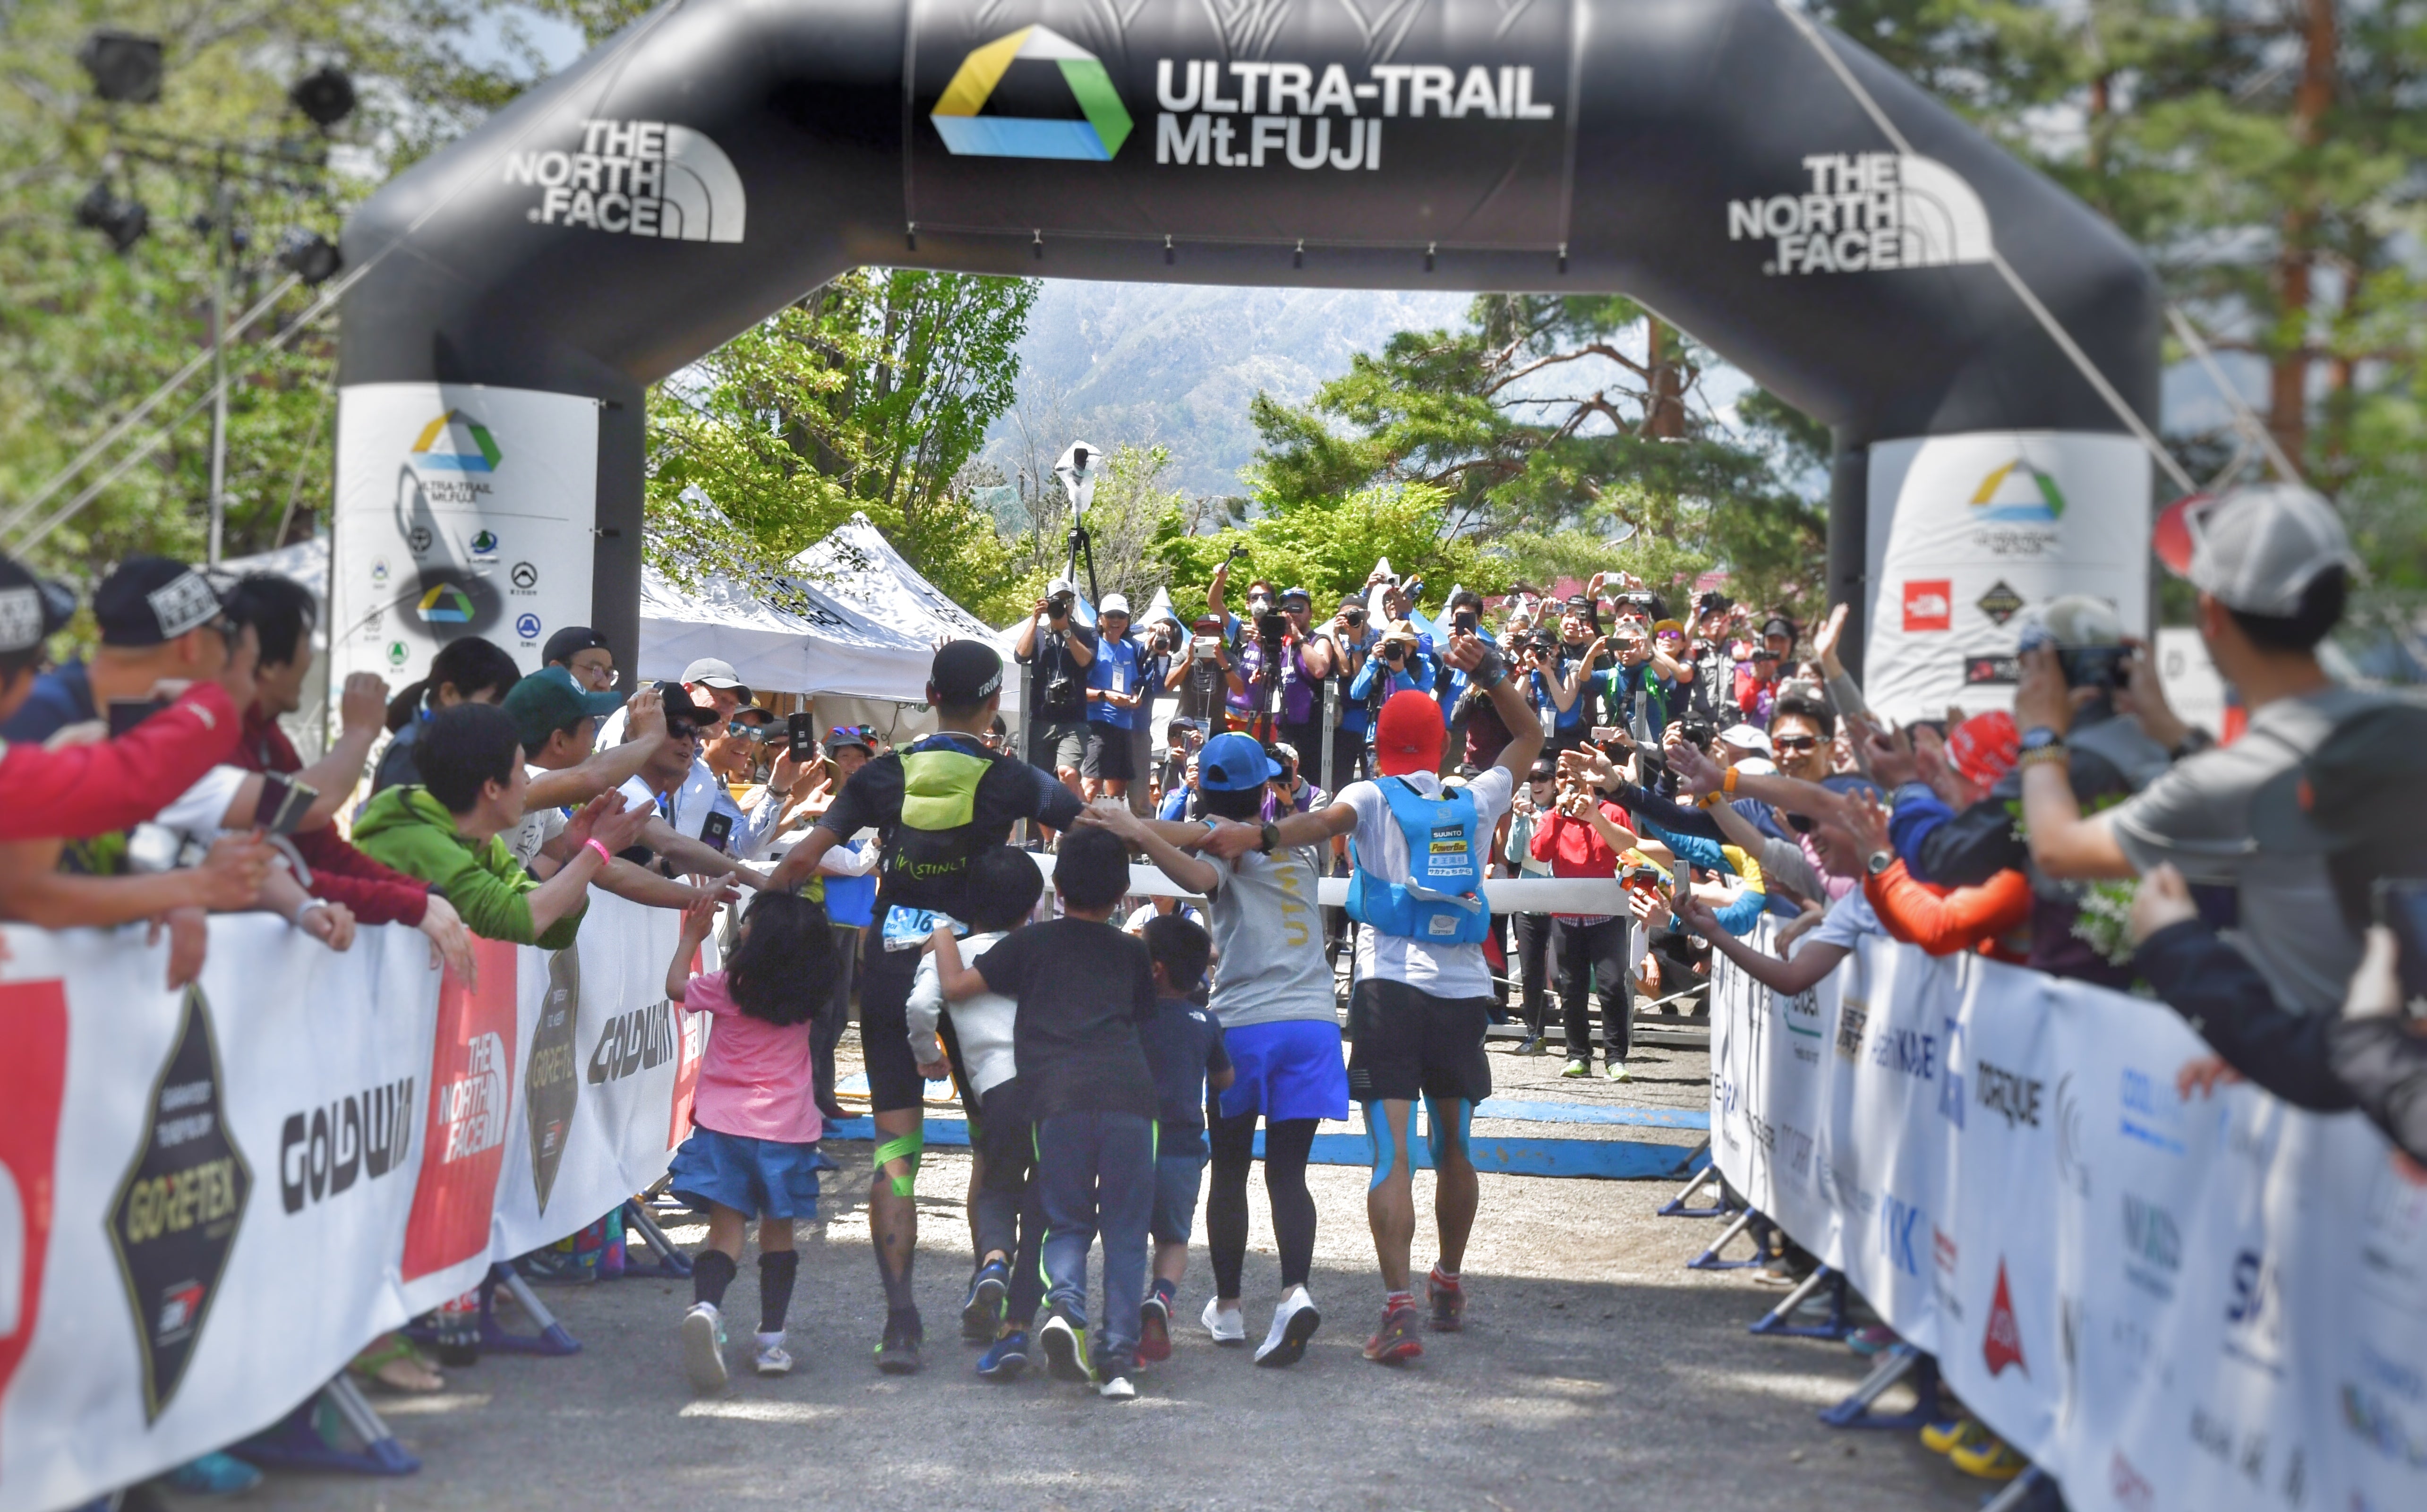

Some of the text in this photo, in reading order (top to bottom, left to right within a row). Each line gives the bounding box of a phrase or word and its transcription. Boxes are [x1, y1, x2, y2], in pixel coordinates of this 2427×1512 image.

[1156, 58, 1554, 120] ULTRA-TRAIL
[580, 120, 665, 161] THE
[1156, 112, 1382, 171] Mt.FUJI
[503, 150, 662, 198] NORTH
[1802, 152, 1899, 195] THE
[542, 188, 659, 237] FACE
[1727, 193, 1898, 240] NORTH
[1777, 231, 1899, 275] FACE
[1432, 842, 1466, 852] PowerBar
[1433, 830, 1462, 838] SUUNTO
[468, 1032, 492, 1076] THE
[437, 1074, 489, 1126] NORTH
[442, 1112, 486, 1164] FACE
